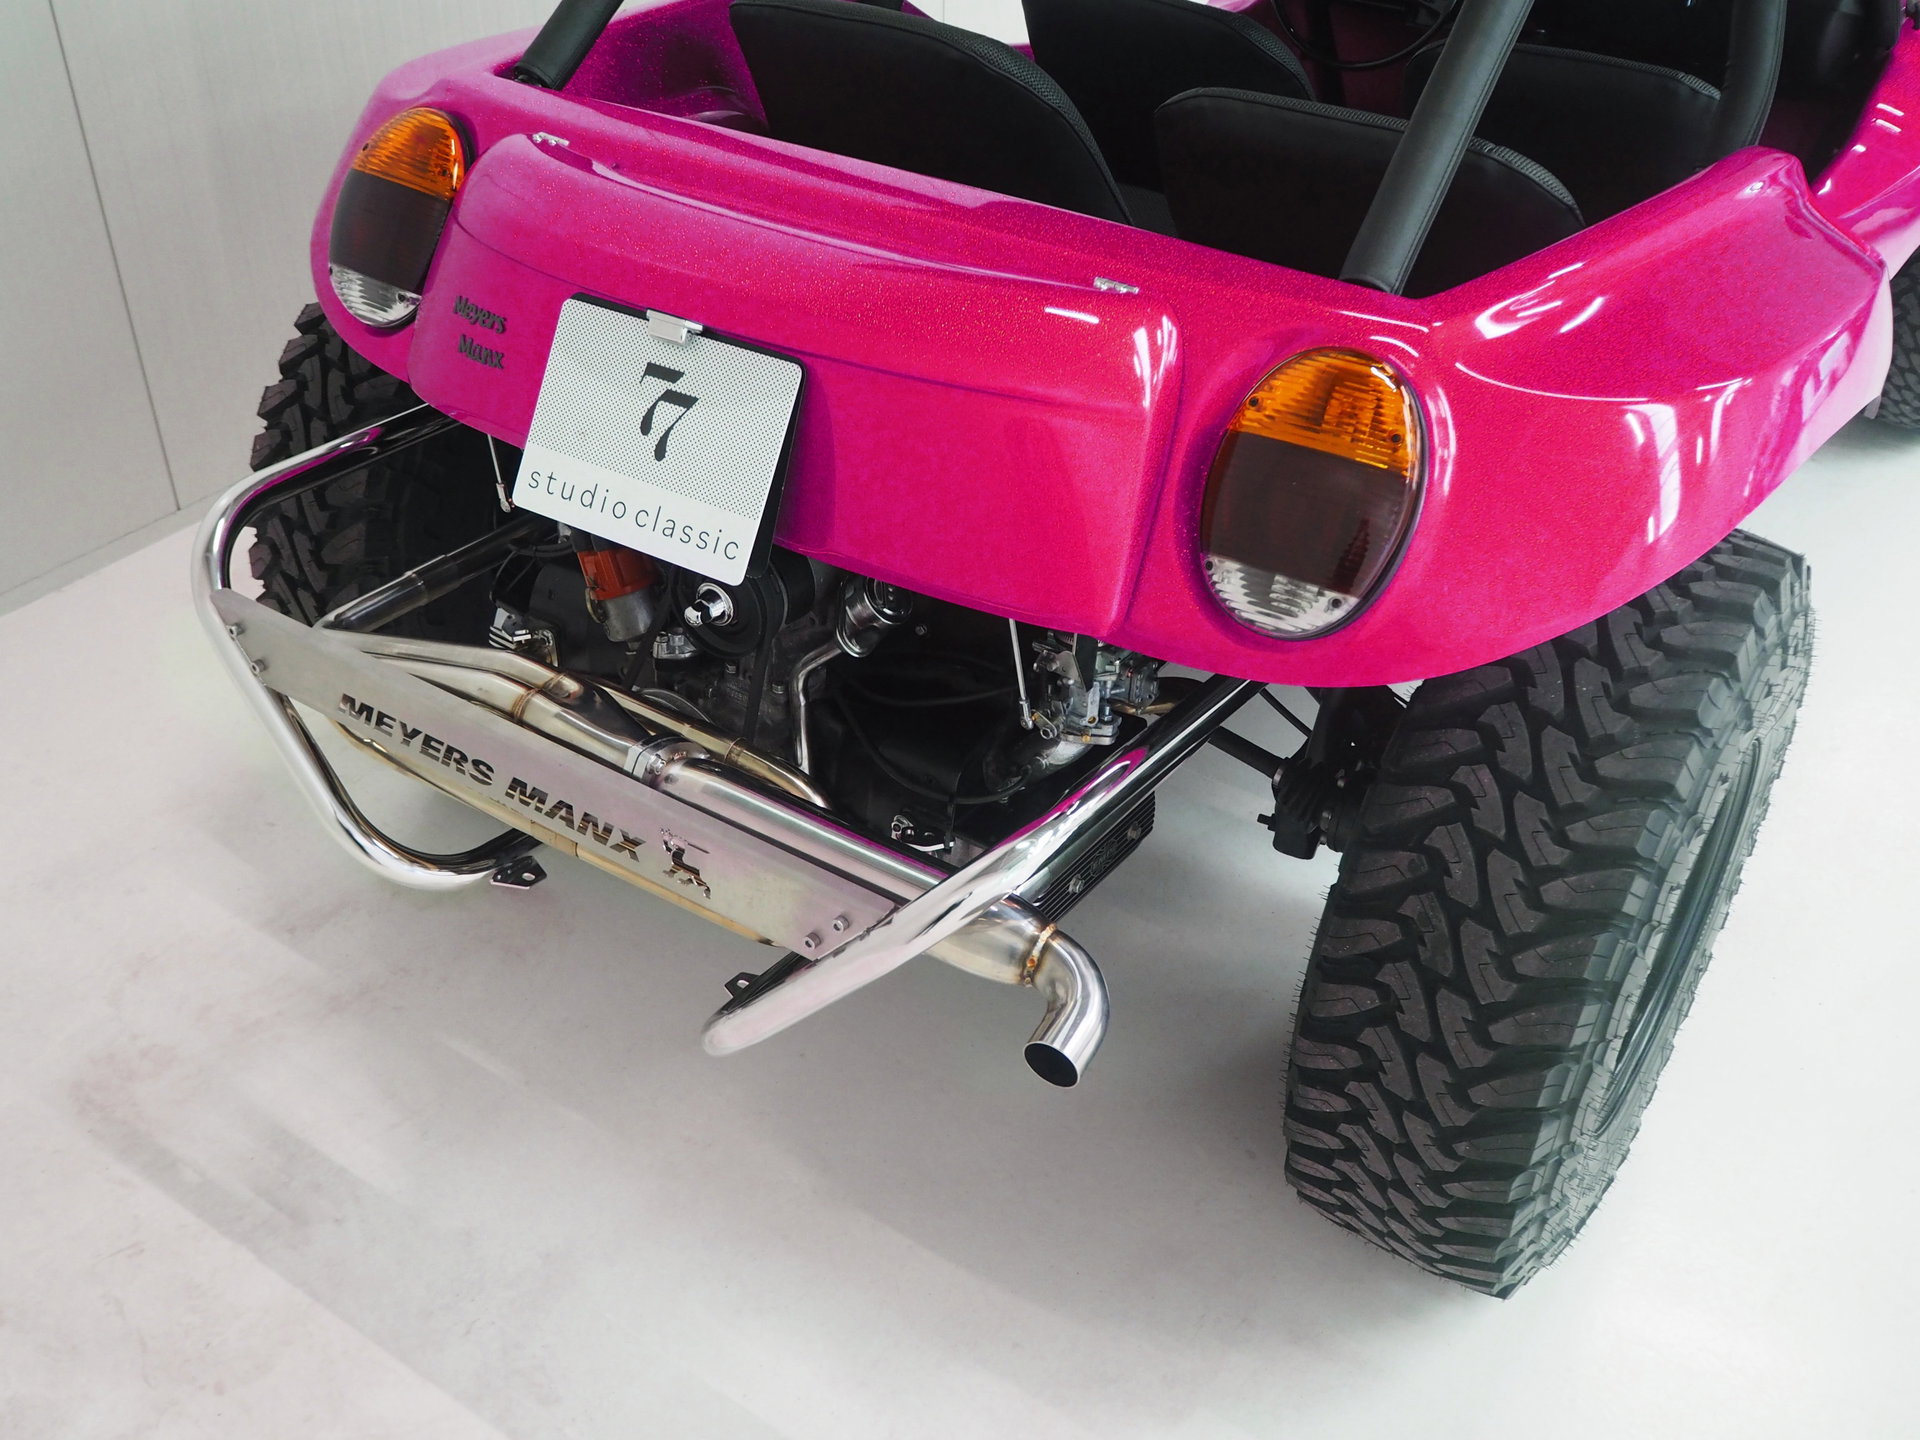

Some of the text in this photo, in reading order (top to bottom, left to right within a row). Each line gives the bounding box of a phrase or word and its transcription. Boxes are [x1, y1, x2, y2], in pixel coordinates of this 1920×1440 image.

[453, 295, 507, 334] Meyers
[458, 334, 504, 369] Manx
[337, 693, 647, 862] MEYERS MANX
